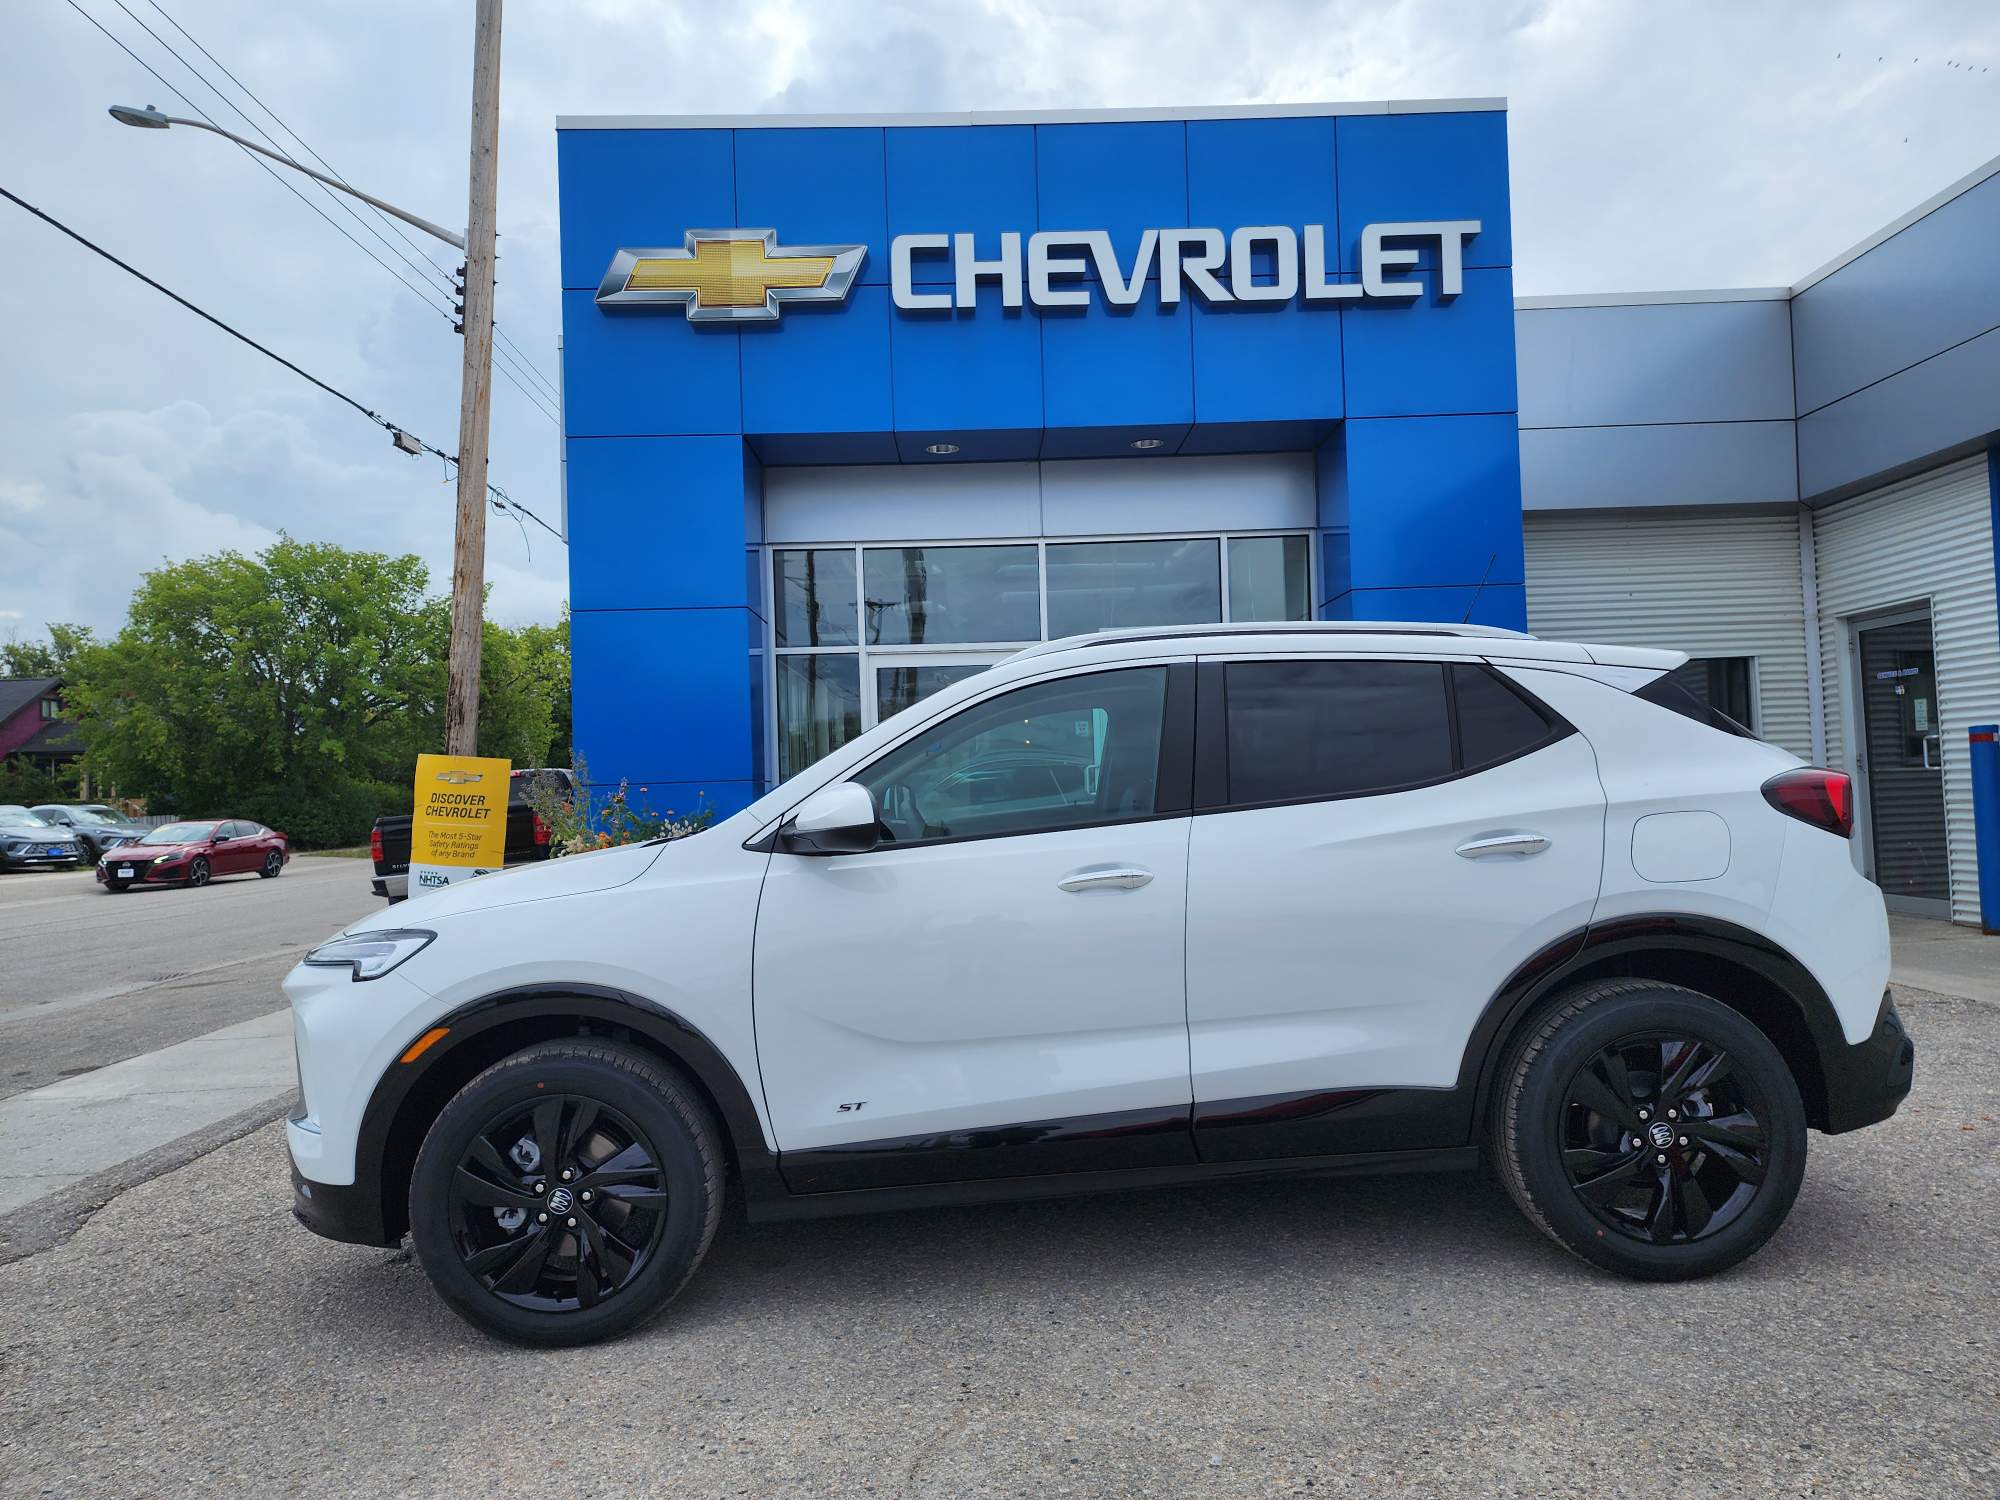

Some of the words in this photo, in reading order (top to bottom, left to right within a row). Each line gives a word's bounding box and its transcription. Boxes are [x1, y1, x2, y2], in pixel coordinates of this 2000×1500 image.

[890, 219, 1482, 311] CHEVROLET
[431, 792, 486, 806] DISCOVER
[425, 805, 491, 819] CHEVROLET
[428, 831, 439, 839] The
[440, 832, 458, 840] Most
[458, 832, 482, 841] 5-Star
[429, 840, 450, 849] Safety
[450, 841, 479, 851] Ratings
[431, 849, 438, 857] of
[452, 850, 475, 858] Brand
[419, 874, 450, 885] NHTSA
[836, 1101, 867, 1113] ST
